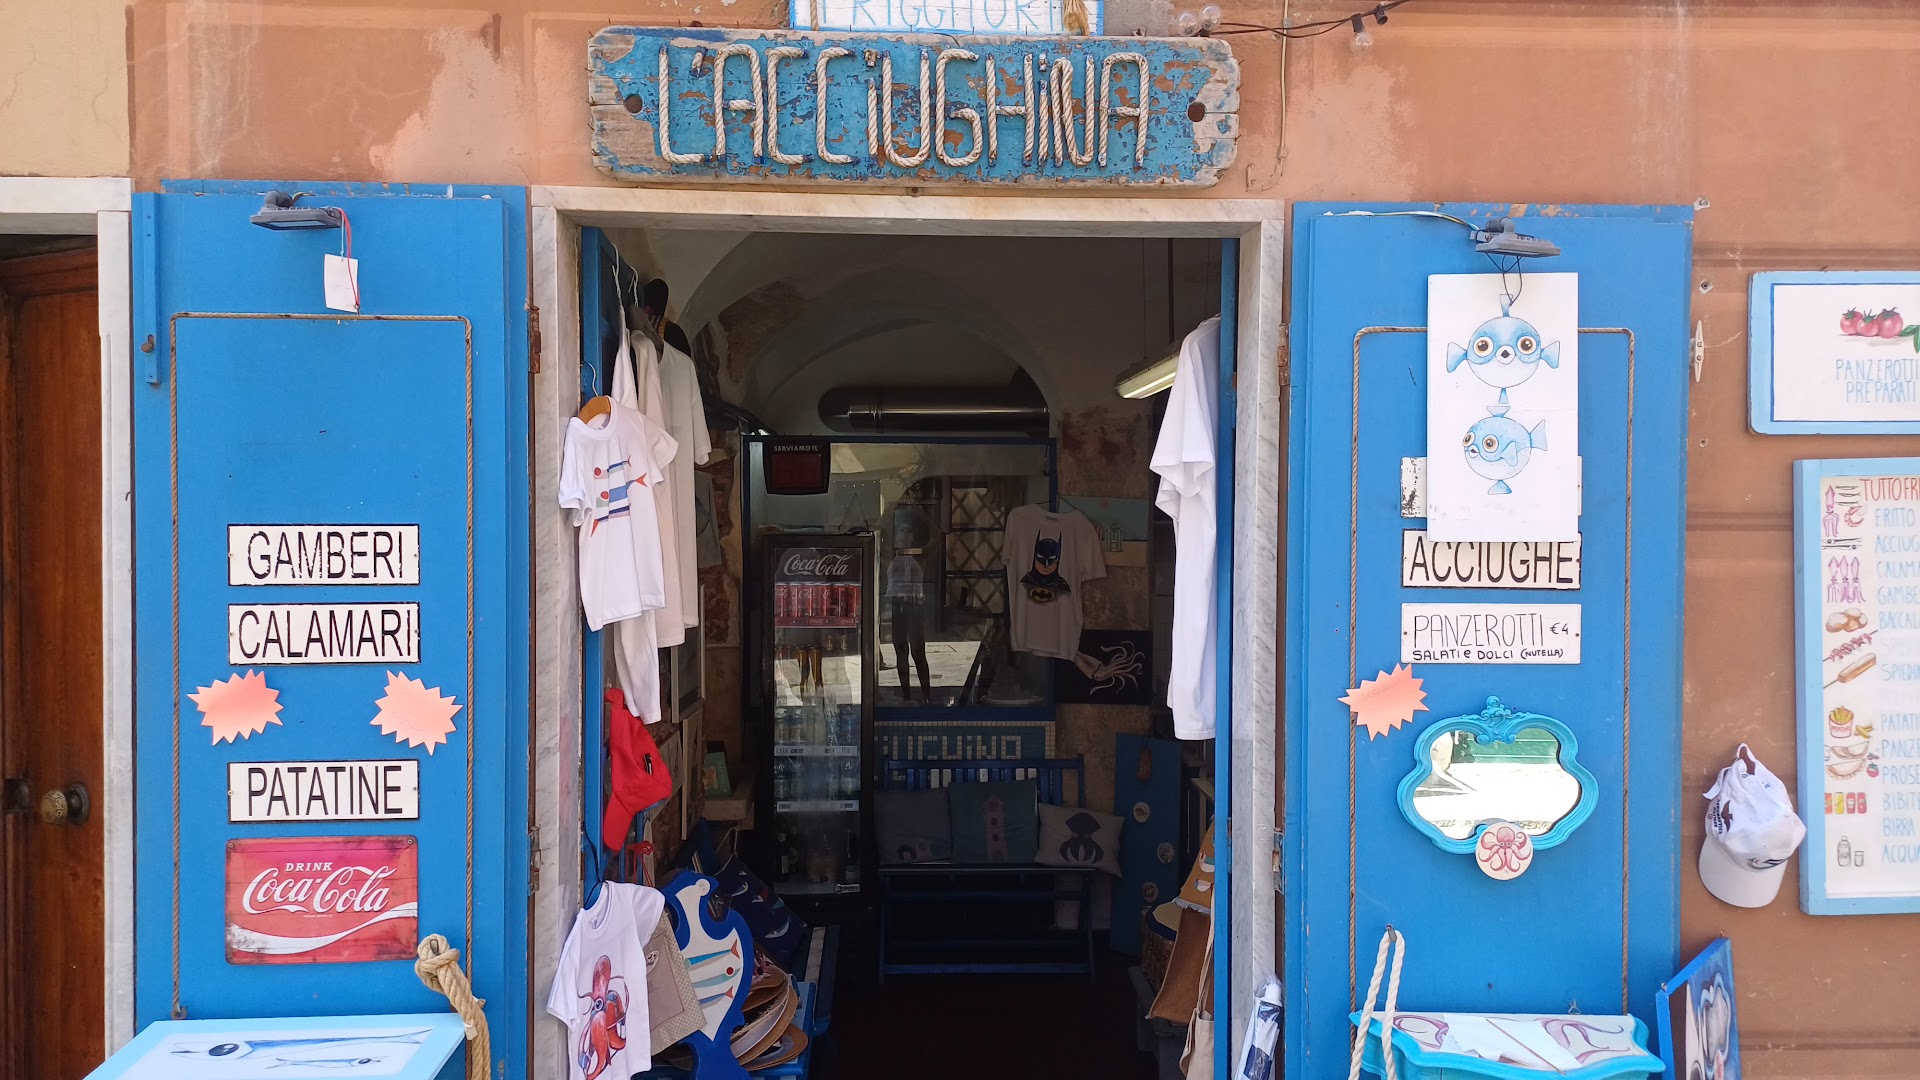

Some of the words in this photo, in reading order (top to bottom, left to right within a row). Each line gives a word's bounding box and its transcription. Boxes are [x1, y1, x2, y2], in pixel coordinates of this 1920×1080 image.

[1835, 358, 1919, 381] PANZEROTTI
[1846, 380, 1916, 403] PREPARATI
[1859, 477, 1902, 501] TUTTO
[1875, 507, 1915, 527] FRITTO
[247, 530, 403, 580] GAMBERI
[1409, 535, 1574, 583] ACCIUGHE
[238, 608, 413, 659] CALAMARI
[1414, 613, 1544, 648] PANZEROTTI
[1549, 622, 1569, 636] €4
[1412, 649, 1461, 661] SALATI
[1477, 650, 1514, 660] DOLCI
[247, 765, 403, 817] PATATINE
[1882, 817, 1915, 837] BIRRA
[285, 862, 334, 872] DRINK
[242, 866, 398, 914] Coca-Cola
